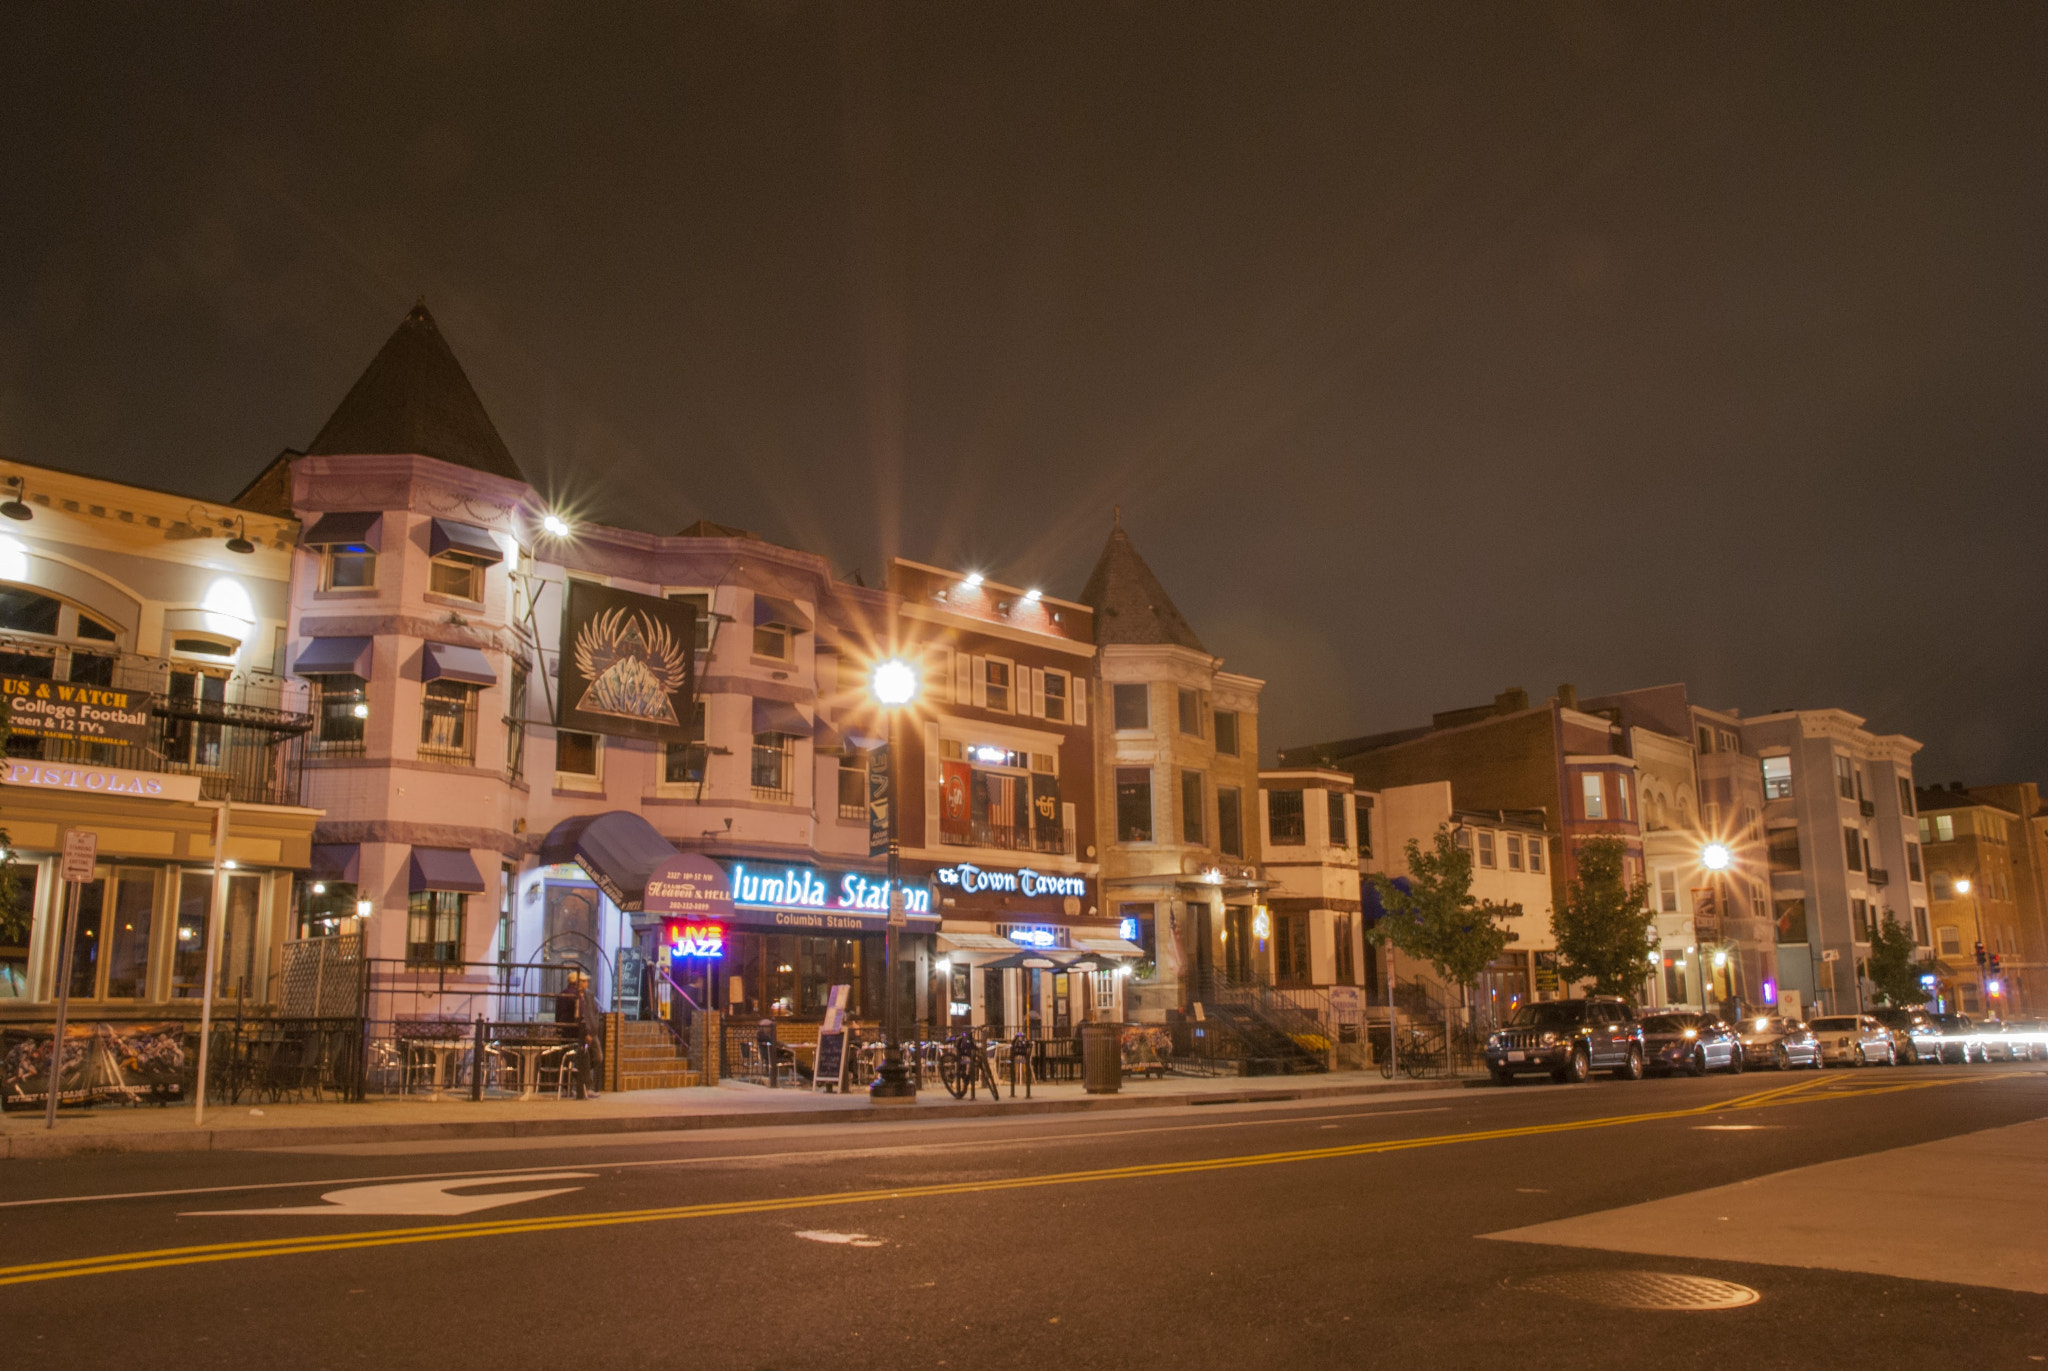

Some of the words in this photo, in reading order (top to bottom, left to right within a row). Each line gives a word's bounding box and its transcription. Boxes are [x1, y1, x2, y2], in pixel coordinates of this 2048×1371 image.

[3, 678, 30, 696] US
[35, 683, 51, 699] &
[57, 685, 128, 709] WATCH
[8, 715, 41, 727] reen
[44, 717, 56, 729] &
[60, 719, 75, 731] 12
[11, 696, 76, 719] College
[80, 705, 147, 726] Football
[6, 764, 163, 795] PISTOLAS
[648, 881, 693, 899] Heaven
[704, 889, 732, 901] HELL
[938, 867, 959, 885] The
[957, 861, 1017, 894] Town
[1017, 866, 1085, 897] Tavern
[838, 872, 929, 912] Staton
[775, 912, 823, 927] Columbia
[827, 914, 863, 929] Station
[671, 925, 722, 942] LIVE
[671, 938, 724, 957] JAZZ
